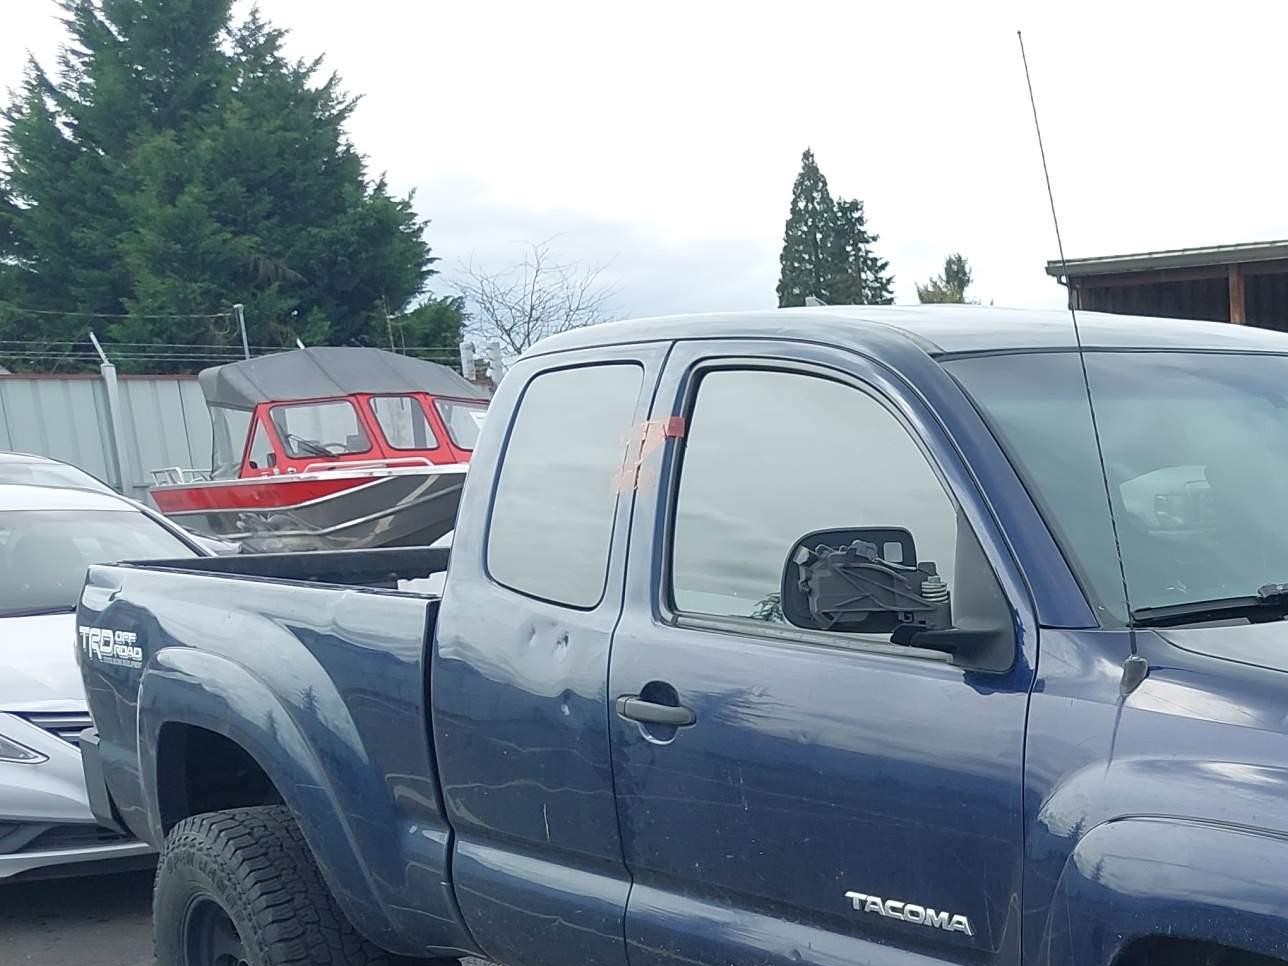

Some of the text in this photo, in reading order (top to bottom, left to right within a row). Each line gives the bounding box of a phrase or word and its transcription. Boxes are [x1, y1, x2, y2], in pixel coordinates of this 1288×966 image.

[79, 625, 137, 661] TRD OFF
[113, 644, 143, 661] ROAD
[844, 890, 974, 936] TACOMA
